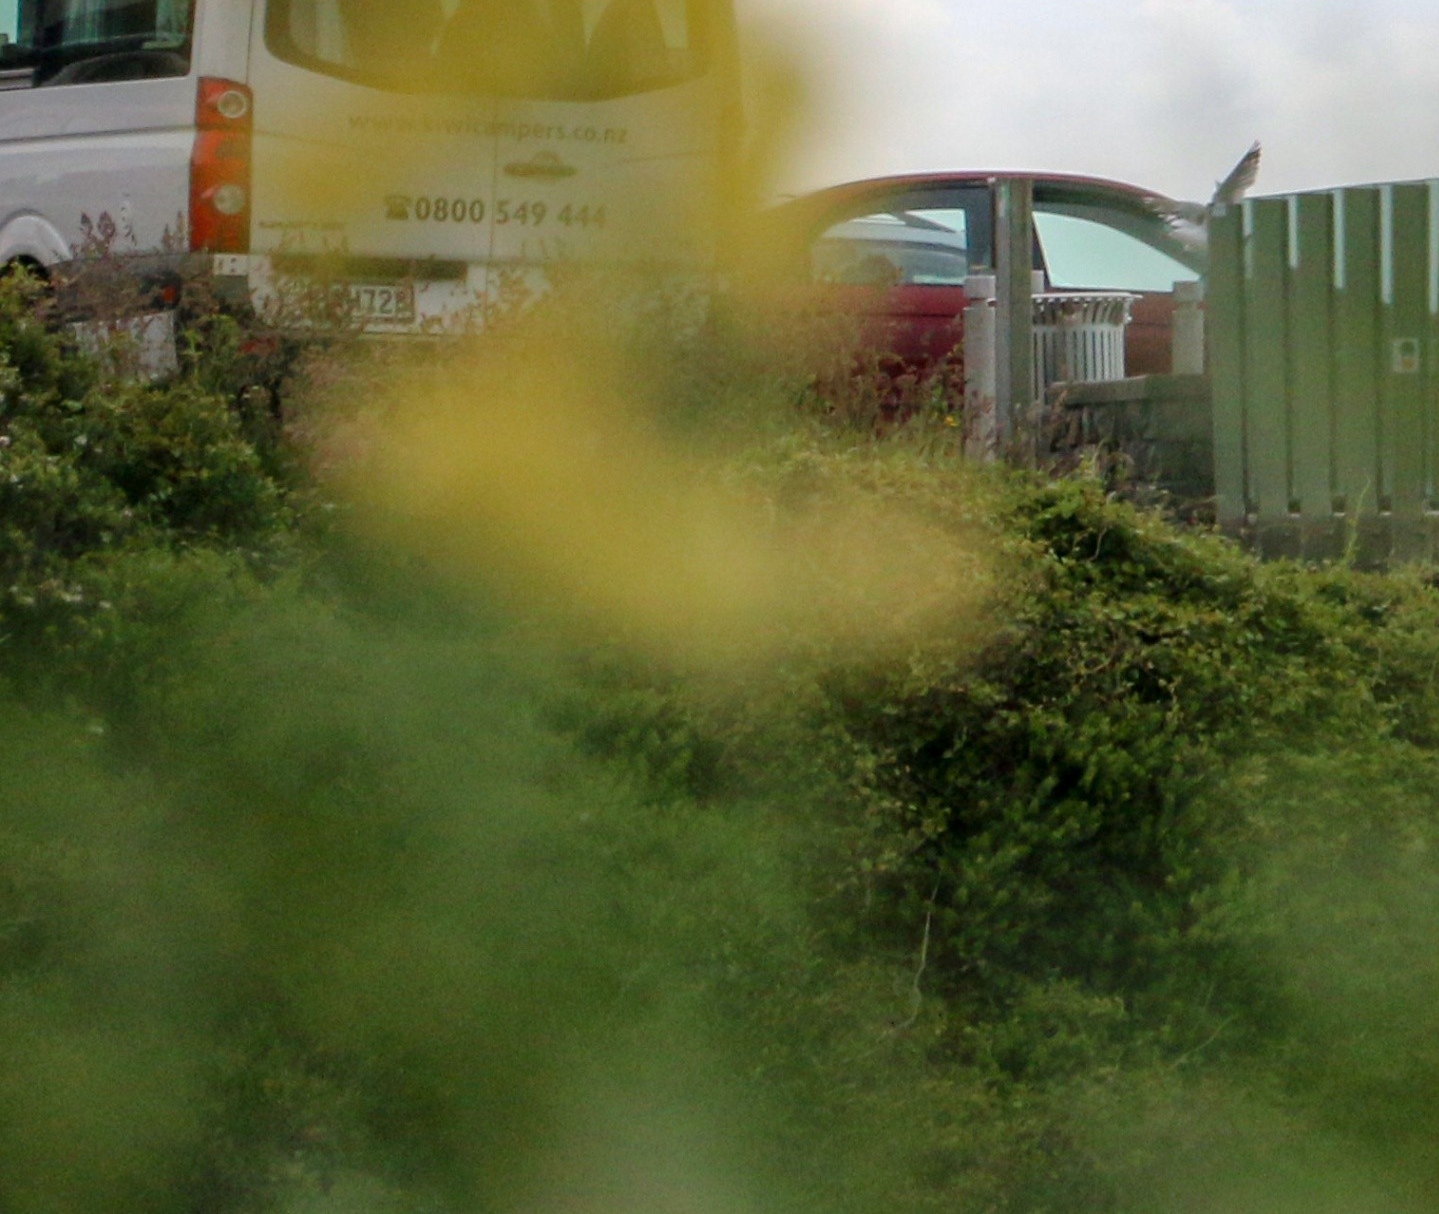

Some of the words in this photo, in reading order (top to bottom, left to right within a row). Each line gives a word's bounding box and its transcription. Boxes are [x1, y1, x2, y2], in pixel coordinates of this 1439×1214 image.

[414, 196, 485, 223] 0800
[496, 199, 546, 226] 549
[556, 202, 606, 229] 444
